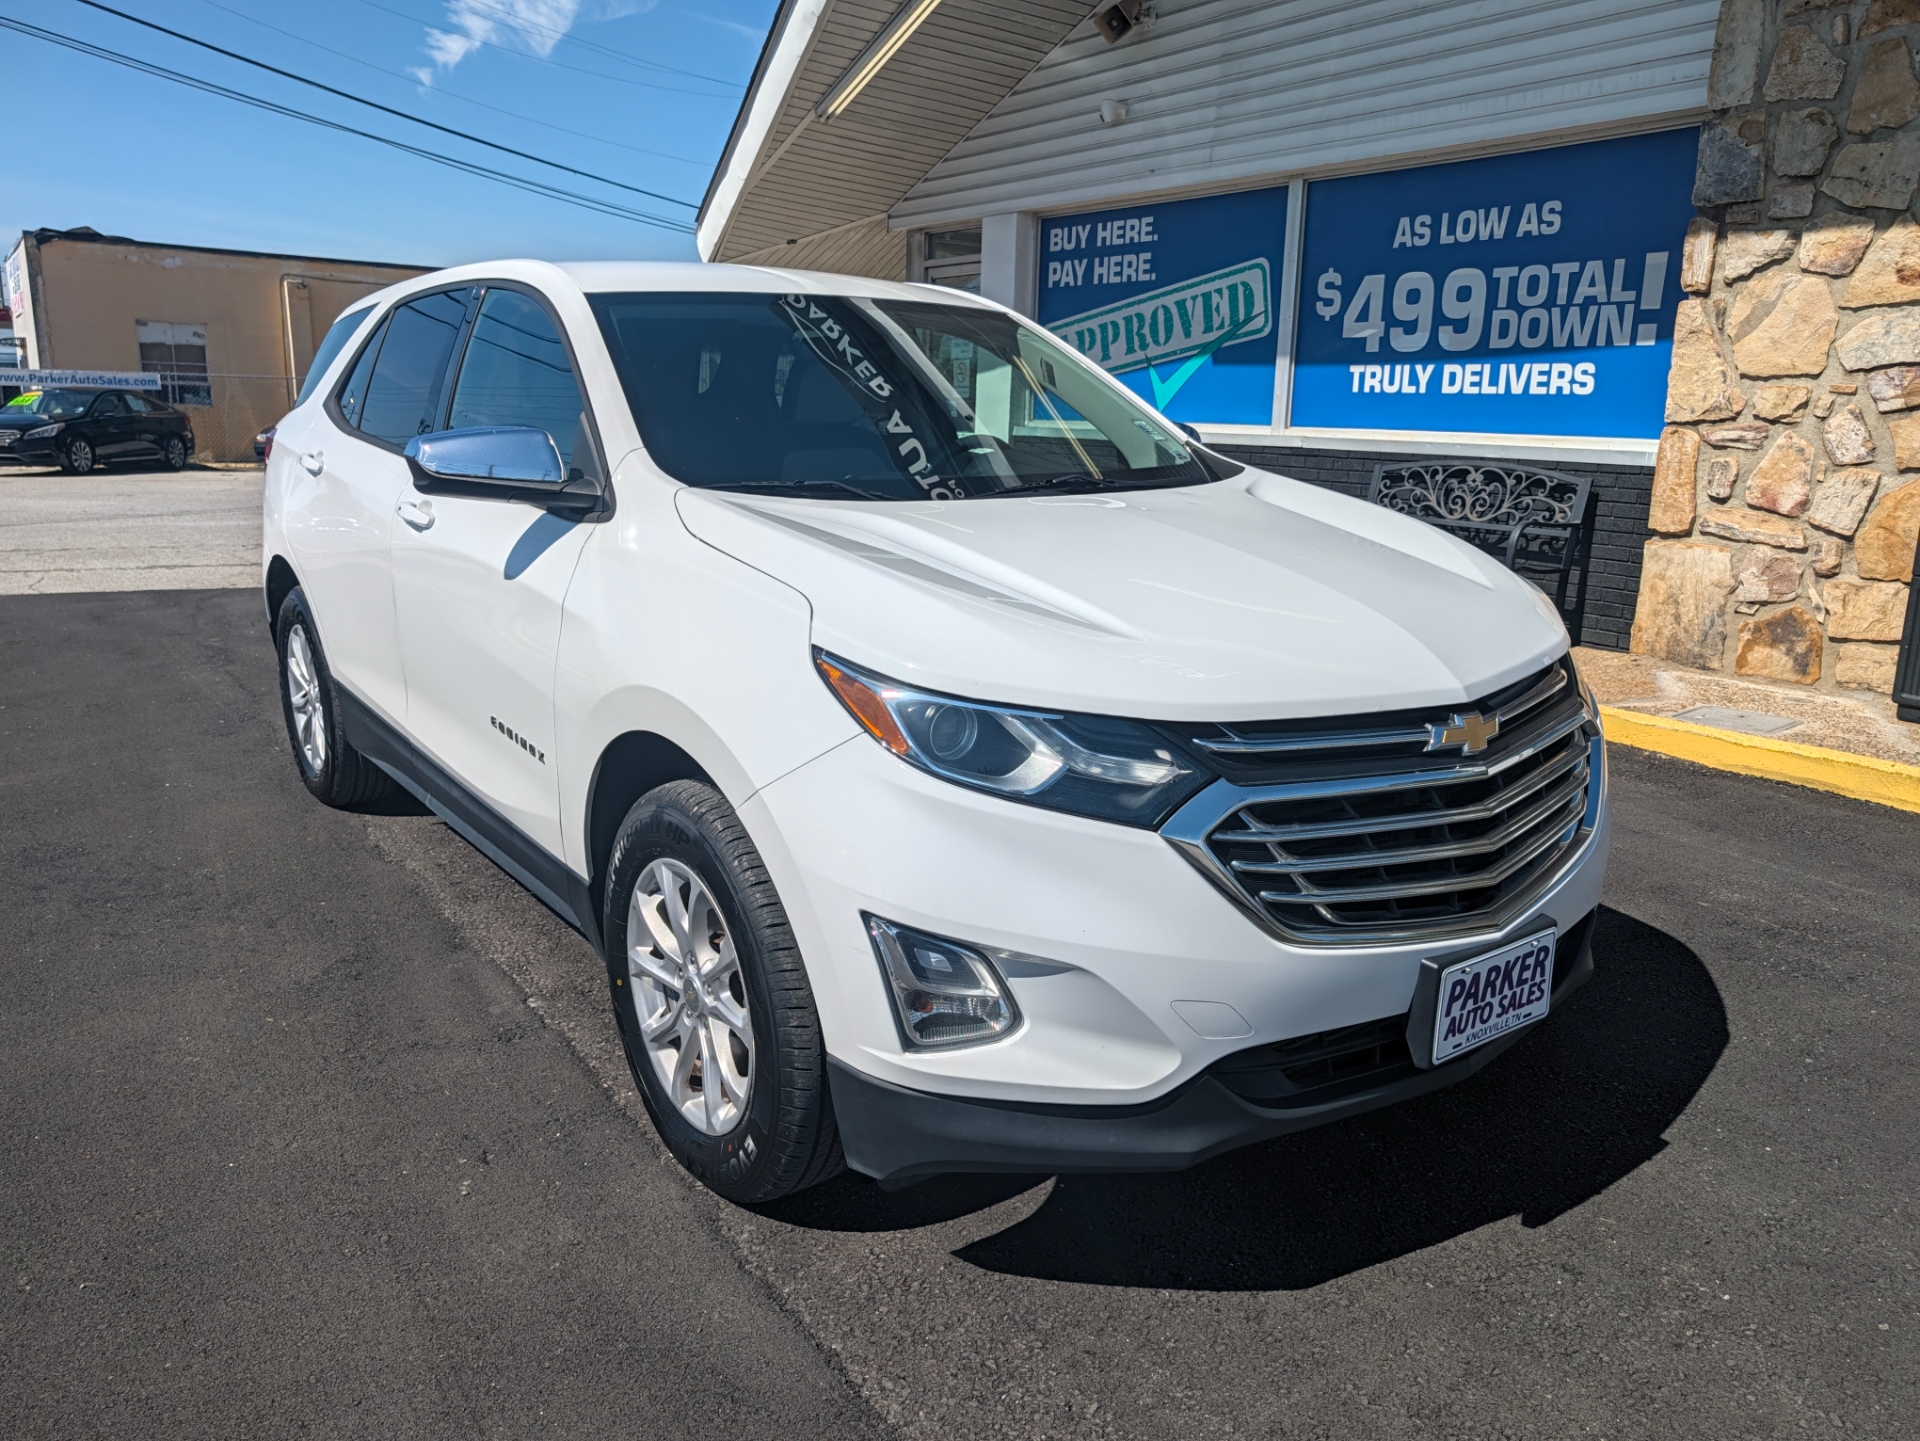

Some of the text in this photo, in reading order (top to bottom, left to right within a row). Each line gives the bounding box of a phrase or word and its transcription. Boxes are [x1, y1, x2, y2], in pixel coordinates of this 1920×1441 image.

[1049, 216, 1158, 252] BUY HERE.
[1392, 200, 1562, 248] AS LOW AS
[1048, 252, 1156, 288] PAY HERE.
[1060, 281, 1255, 362] PPROVED
[1315, 258, 1636, 353] $499 TOTAL
[0, 372, 158, 387] ww.ParkerAutoSales.com
[1350, 362, 1596, 395] TRULY DELIVERS
[1444, 945, 1550, 1018] PARKER
[1443, 979, 1546, 1041] AUTO SALES
